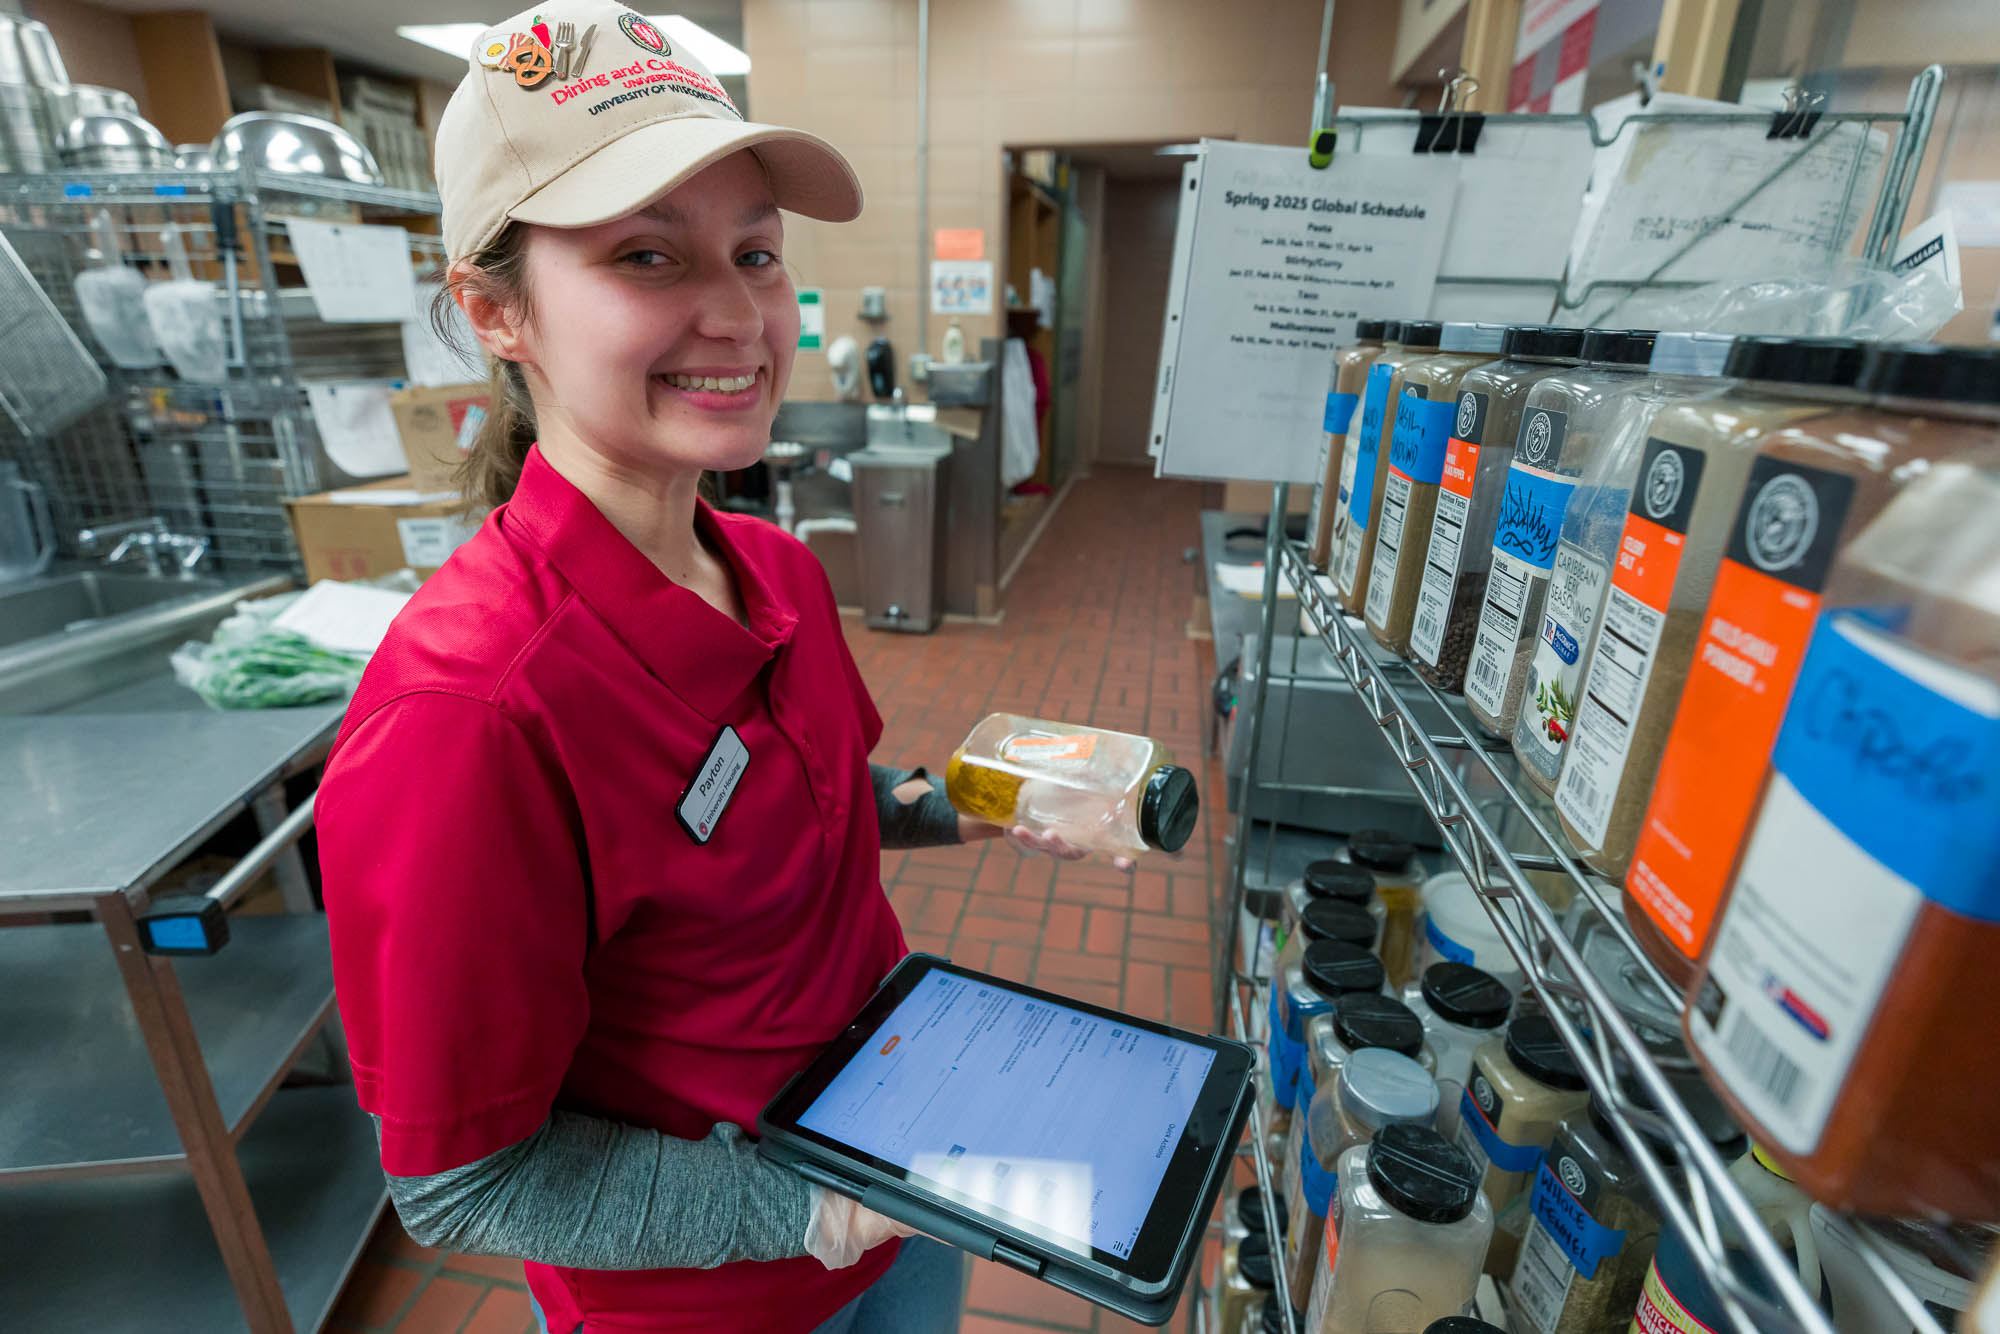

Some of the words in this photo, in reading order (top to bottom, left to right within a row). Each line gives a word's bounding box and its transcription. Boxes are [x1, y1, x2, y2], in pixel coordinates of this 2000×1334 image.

[551, 72, 610, 105] Dining
[611, 60, 646, 80] and
[622, 73, 686, 89] UNIVERSITY
[588, 87, 650, 117] UNIVERSITY
[651, 84, 667, 94] OF
[1225, 190, 1269, 211] Spring
[1274, 194, 1308, 211] 2025
[1312, 198, 1357, 214] Global
[1361, 201, 1427, 220] Schedule
[1557, 551, 1600, 588] CARIBBEAN
[1551, 583, 1592, 624] SEASONING
[699, 755, 725, 797] Payton
[704, 788, 726, 825] University
[723, 762, 742, 790] Housing
[1155, 1137, 1170, 1159] Actions
[1163, 1122, 1176, 1139] Quick
[1540, 1170, 1586, 1232] WHOLE
